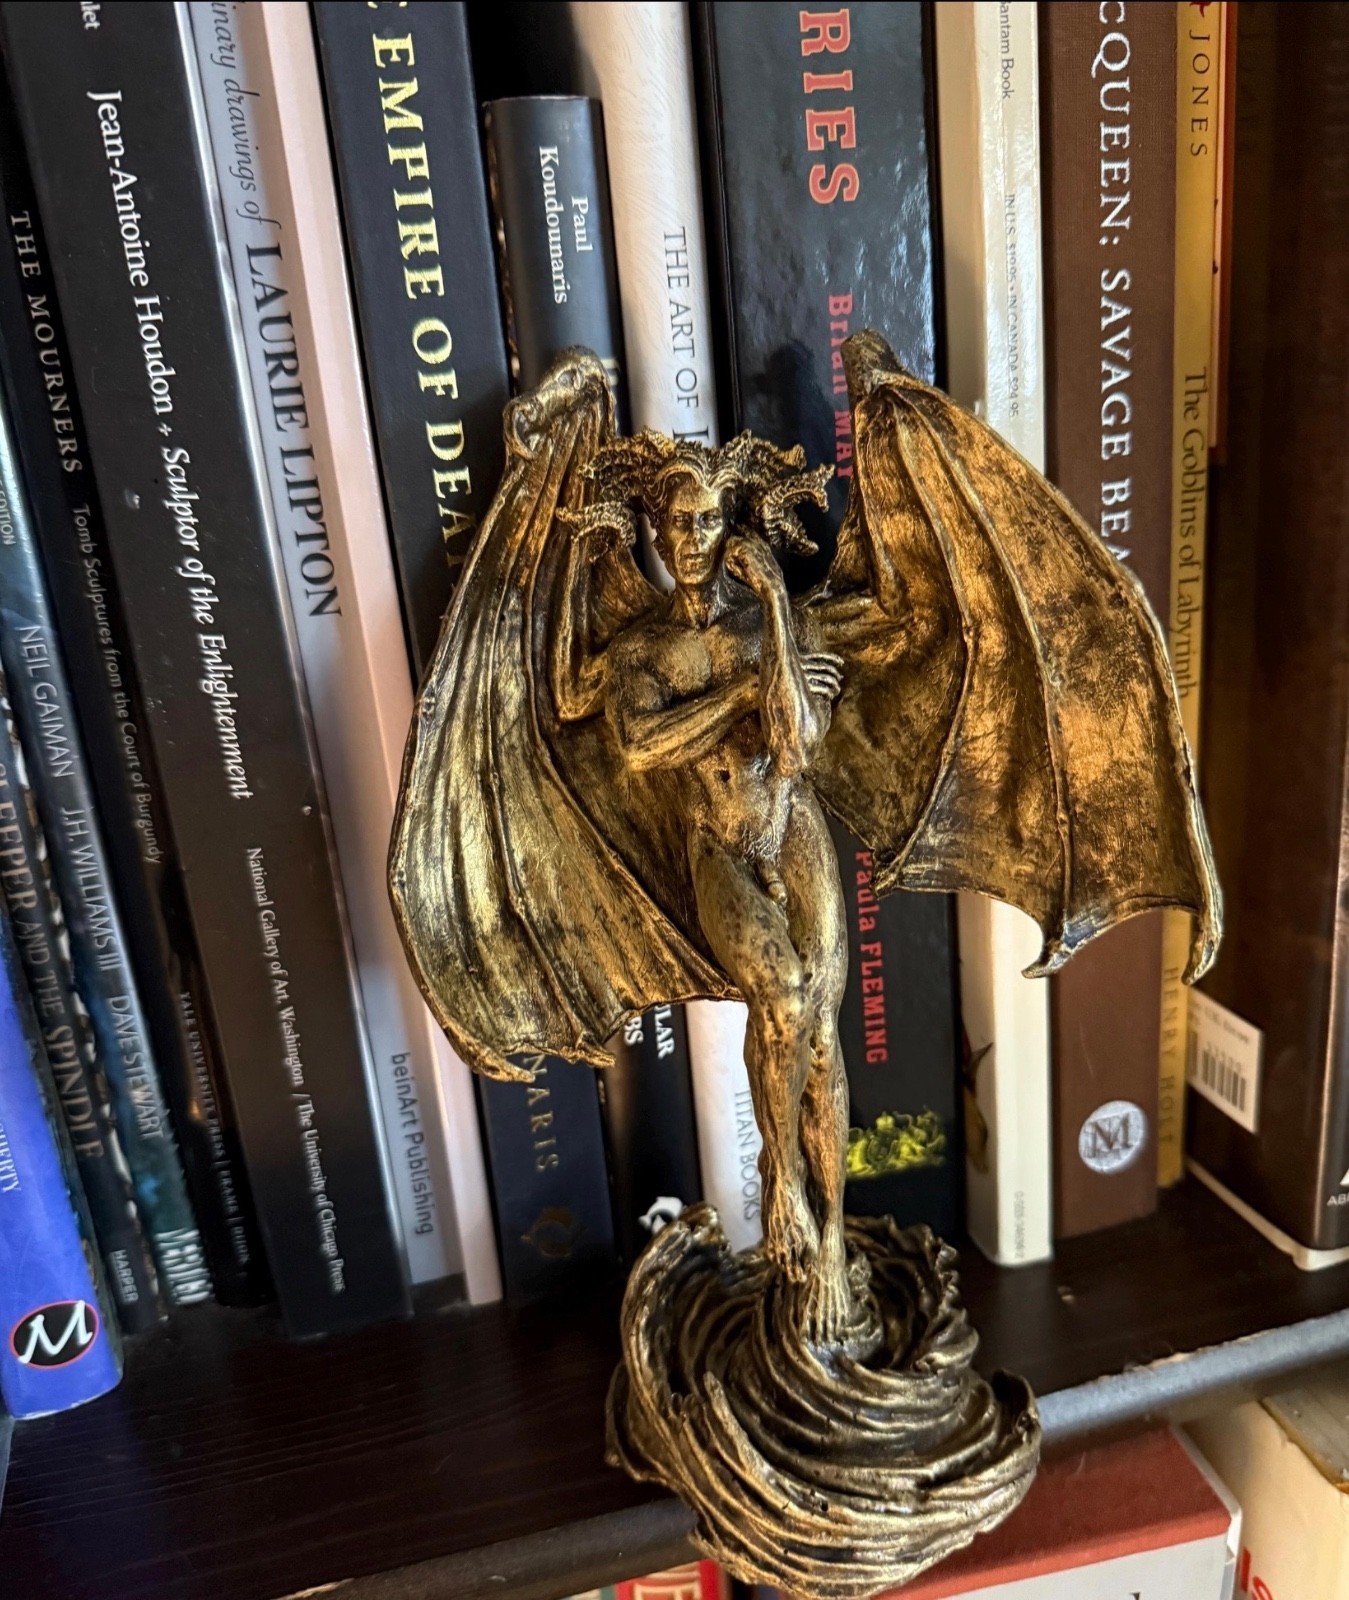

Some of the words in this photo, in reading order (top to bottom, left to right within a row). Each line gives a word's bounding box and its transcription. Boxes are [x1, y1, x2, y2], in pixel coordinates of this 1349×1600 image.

[800, 8, 860, 205] RIES
[1001, 58, 1015, 99] Book
[1189, 30, 1210, 157] JONES
[224, 78, 260, 192] drawings
[236, 200, 282, 230] of
[373, 33, 446, 300] EMPIRE
[411, 316, 460, 400] OF
[538, 145, 572, 304] Koudounaris
[571, 195, 594, 254] Paul
[86, 90, 150, 287] Jean-Antoine
[134, 295, 174, 415] Houdon
[663, 226, 691, 289] THE
[10, 211, 41, 278] THE
[27, 295, 82, 473] MOURNERS
[246, 242, 310, 433] LAURIE
[670, 300, 696, 358] ART
[675, 367, 700, 409] OF
[1100, 268, 1132, 461] SAVAGE
[1184, 367, 1208, 422] The
[161, 447, 201, 551] Sculptor
[1180, 429, 1206, 539] Goblins
[73, 503, 97, 554] Tomb
[280, 445, 342, 618] LIPTON
[1179, 544, 1200, 568] of
[84, 558, 113, 646] Sculptures
[175, 557, 216, 587] of
[187, 587, 220, 625] the
[1170, 574, 1200, 699] Labyrinth
[19, 625, 50, 680] NEIL
[104, 650, 122, 688] from
[35, 682, 76, 778] GAIMAN
[113, 692, 131, 719] the
[198, 633, 254, 799] Enlightenment
[121, 722, 141, 772] Court
[130, 772, 148, 788] of
[61, 807, 89, 842] J.H.
[134, 794, 165, 864] Burgundy
[71, 845, 117, 949] WILLIAMS
[248, 847, 274, 907] National
[17, 920, 50, 965] AND
[98, 953, 123, 970] III
[261, 909, 281, 957] Gallery
[35, 970, 64, 1016] THE
[270, 961, 289, 976] of
[108, 995, 138, 1046] DAVE
[860, 941, 888, 1064] FLEMING
[1161, 966, 1180, 1056] HENRY
[278, 1006, 305, 1086] Washington
[43, 1025, 103, 1158] SPINDLE
[124, 1048, 165, 1139] STEWART
[297, 1100, 315, 1128] The
[391, 1052, 419, 1128] beinArt
[735, 1086, 758, 1146] TITAN
[1160, 1075, 1176, 1144] HOLT
[305, 1128, 328, 1192] University
[404, 1131, 435, 1236] Publishing
[740, 1151, 761, 1221] BOOKS
[318, 1193, 334, 1209] of
[320, 1208, 338, 1257] Chicago
[113, 1249, 139, 1303] HARPER
[328, 1258, 346, 1294] Press
